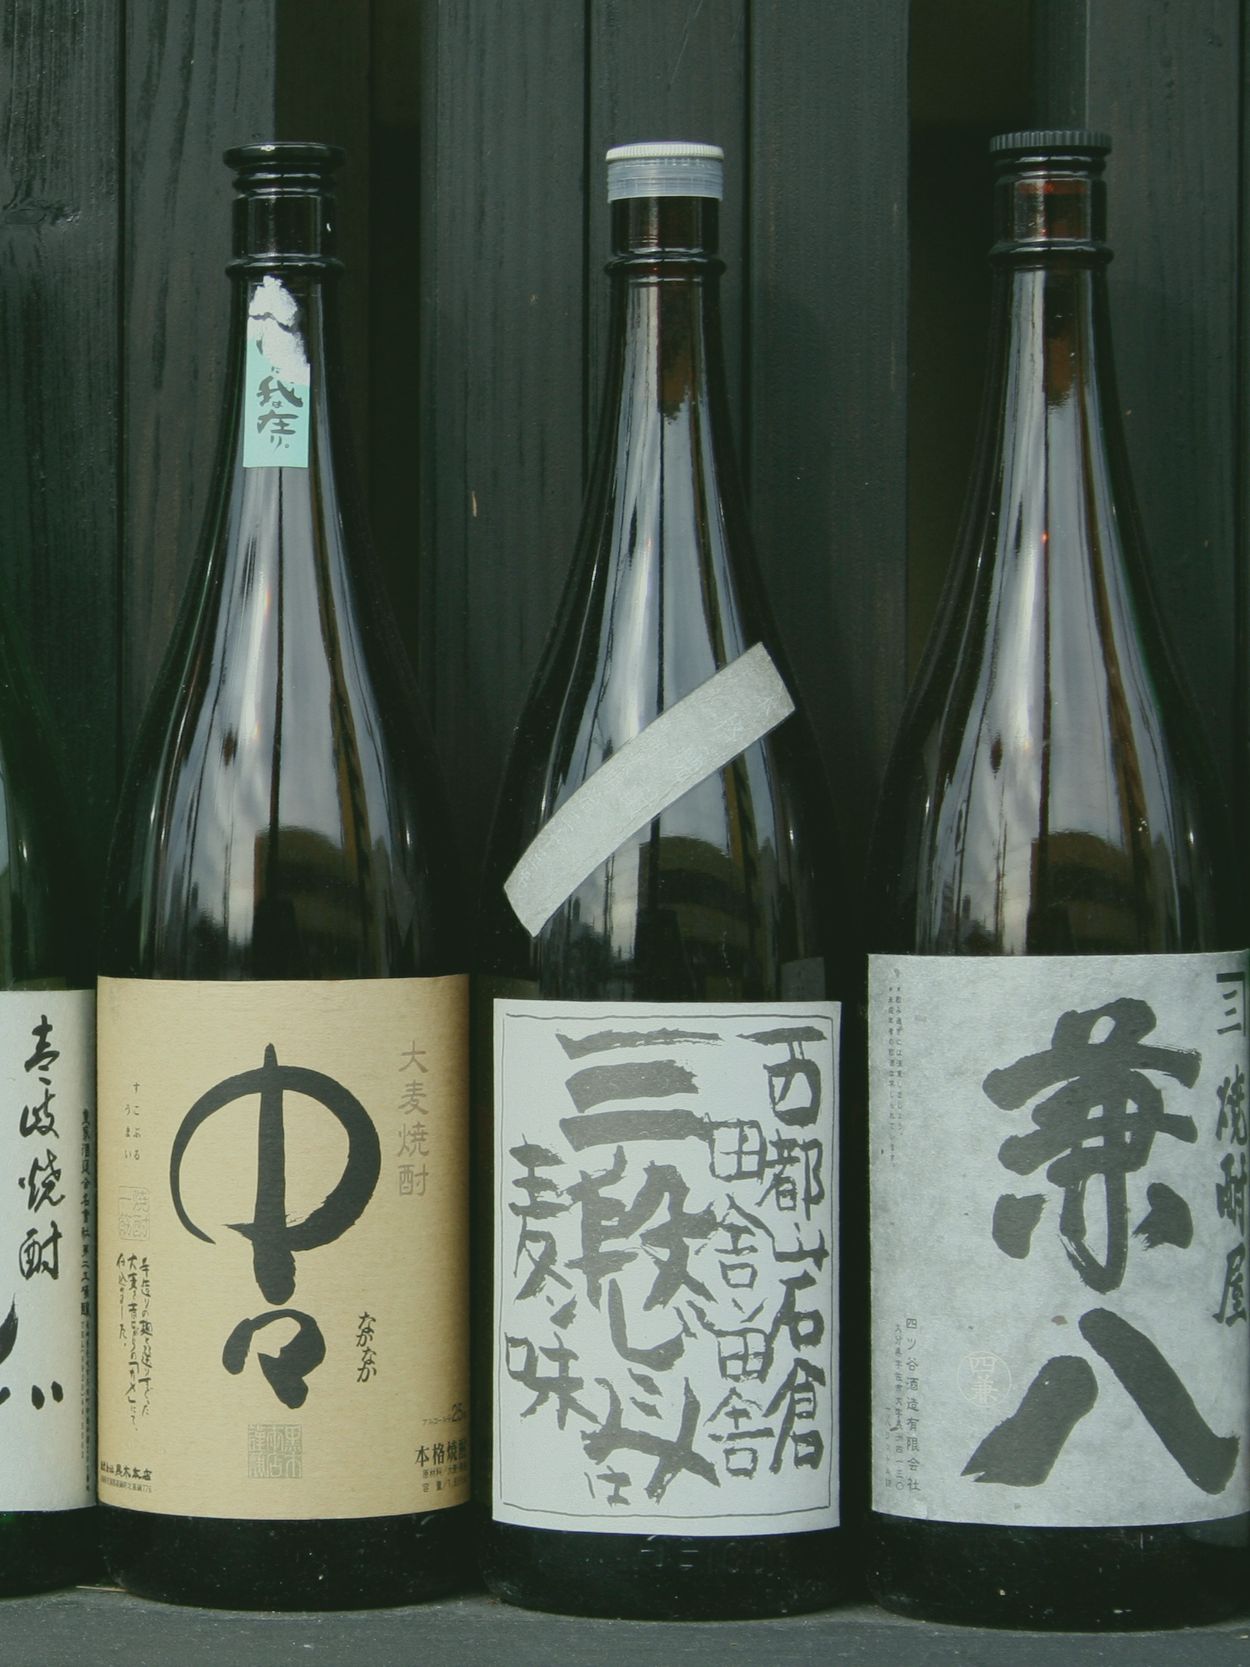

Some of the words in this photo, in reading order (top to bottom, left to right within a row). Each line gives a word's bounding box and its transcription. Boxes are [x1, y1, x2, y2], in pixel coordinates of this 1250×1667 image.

[397, 1039, 430, 1198] 大麦焼酎
[168, 1042, 382, 1411] 中々
[960, 996, 1243, 1496] 兼八
[355, 1311, 378, 1384] なかなか
[905, 1318, 922, 1494] 四ツ谷酒造有限会社
